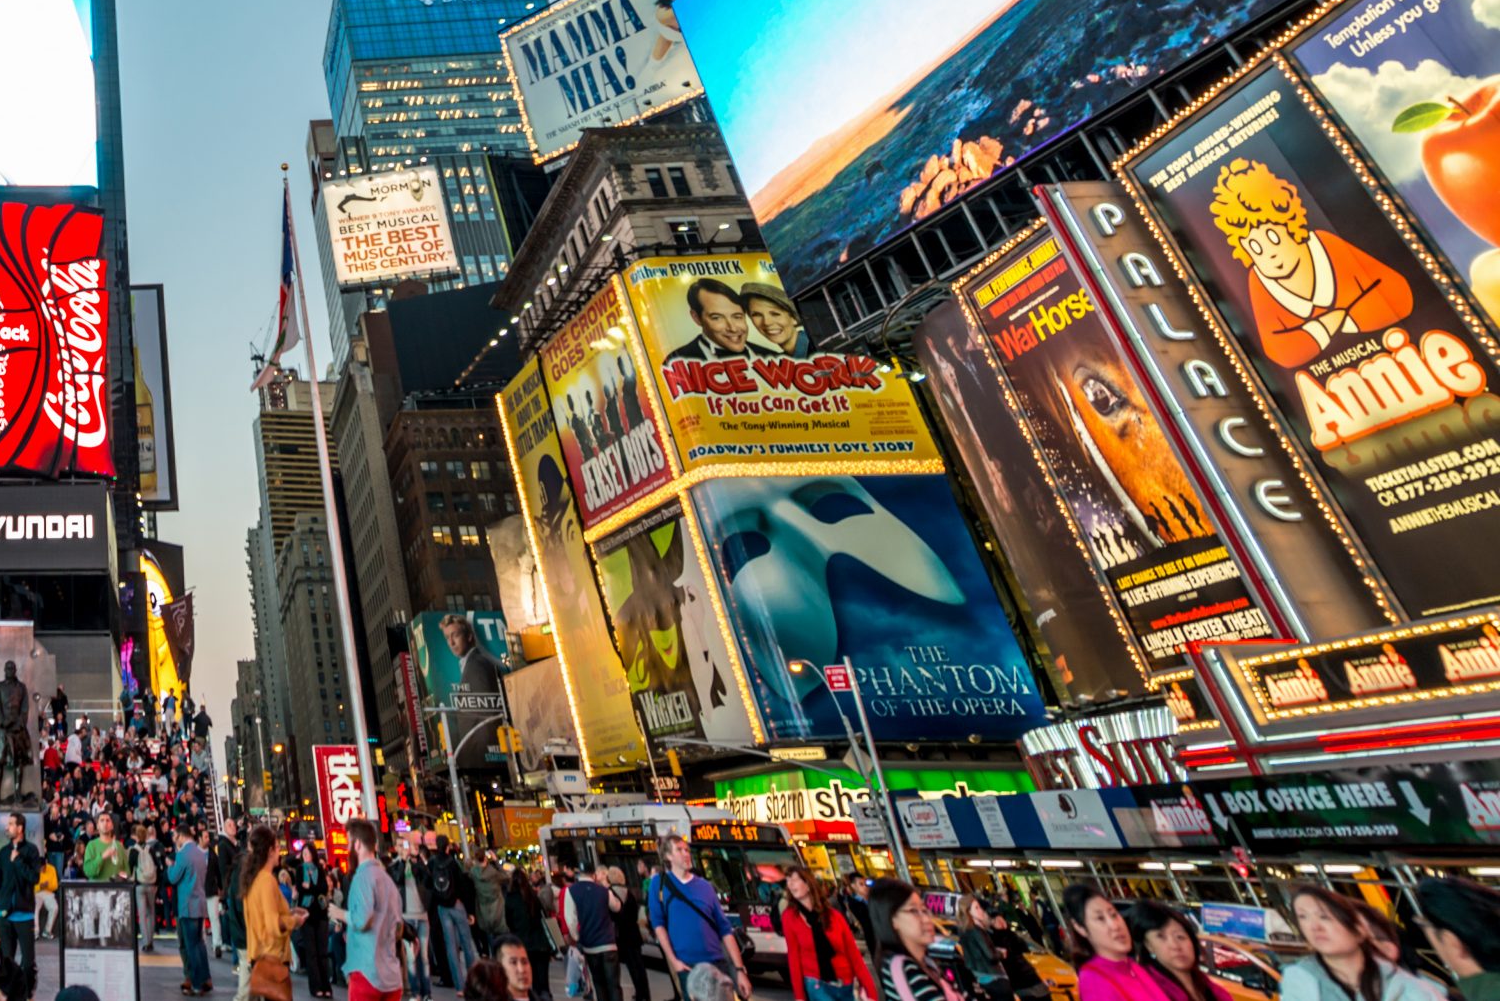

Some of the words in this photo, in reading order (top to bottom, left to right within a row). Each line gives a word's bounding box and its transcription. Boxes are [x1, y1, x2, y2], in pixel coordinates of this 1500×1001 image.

[1348, 23, 1396, 58] Unless
[1394, 4, 1423, 34] you
[556, 45, 636, 119] MIA!
[1149, 170, 1168, 189] THE
[1165, 153, 1195, 178] TONY
[1193, 89, 1282, 157] AWARD-WINNING
[1162, 171, 1187, 195] BEST
[1184, 142, 1231, 177] MUSICAL
[1226, 108, 1281, 153] RETURNS!
[339, 222, 372, 235] BEST
[377, 213, 439, 229] MUSICAL
[379, 209, 401, 218] TONY
[401, 204, 438, 215] AWARDS
[343, 243, 417, 264] MUSICAL
[420, 239, 445, 253] OF
[387, 224, 441, 245] BEST
[346, 261, 377, 274] THIS
[668, 259, 744, 277] BRODERICK
[546, 332, 570, 362] THE
[569, 286, 618, 341] CROWD
[550, 342, 586, 383] GOES
[1090, 201, 1303, 522] PALACE
[1309, 357, 1334, 377] THE
[1330, 338, 1382, 368] MUSICAL
[662, 355, 760, 401] NICE
[752, 354, 884, 397] WORK
[1294, 327, 1488, 451] Annie
[707, 395, 723, 417] If
[728, 395, 760, 415] You
[761, 395, 795, 412] Can
[798, 395, 830, 414] Get
[832, 394, 850, 413] It
[719, 420, 739, 432] The
[740, 420, 810, 434] Tony-Winning
[811, 419, 850, 431] Musical
[580, 440, 629, 513] JERSEY
[620, 418, 665, 486] BOYS
[688, 441, 767, 461] BROADWAY'S
[769, 442, 831, 455] FUNNIEST
[834, 441, 870, 455] LOVE
[872, 440, 915, 453] STORY
[1364, 438, 1500, 493] TICKETMASTER.COM
[1377, 490, 1399, 507] OR
[1115, 574, 1134, 591] LAST
[1131, 567, 1158, 587] CHANCE
[1154, 565, 1166, 578] TO
[1163, 560, 1179, 576] SEE
[1177, 558, 1185, 572] IT
[1183, 554, 1194, 570] ON
[1141, 628, 1187, 653] LINCOLN
[1182, 616, 1226, 641] CENTER
[903, 644, 950, 665] THE
[451, 682, 472, 693] THE
[853, 663, 1033, 698] PHANTOM
[1264, 671, 1329, 708] Annie
[1342, 655, 1417, 696] Annie
[870, 698, 899, 718] OF
[909, 698, 950, 717] THE
[951, 697, 1027, 717] OPERA
[327, 753, 362, 825] tkts
[766, 783, 805, 822] sbarro
[1222, 790, 1269, 815] BOX
[1269, 786, 1335, 813] OFFICE
[1333, 780, 1397, 809] HERE
[745, 826, 759, 840] ST
[1151, 794, 1212, 835] Annie
